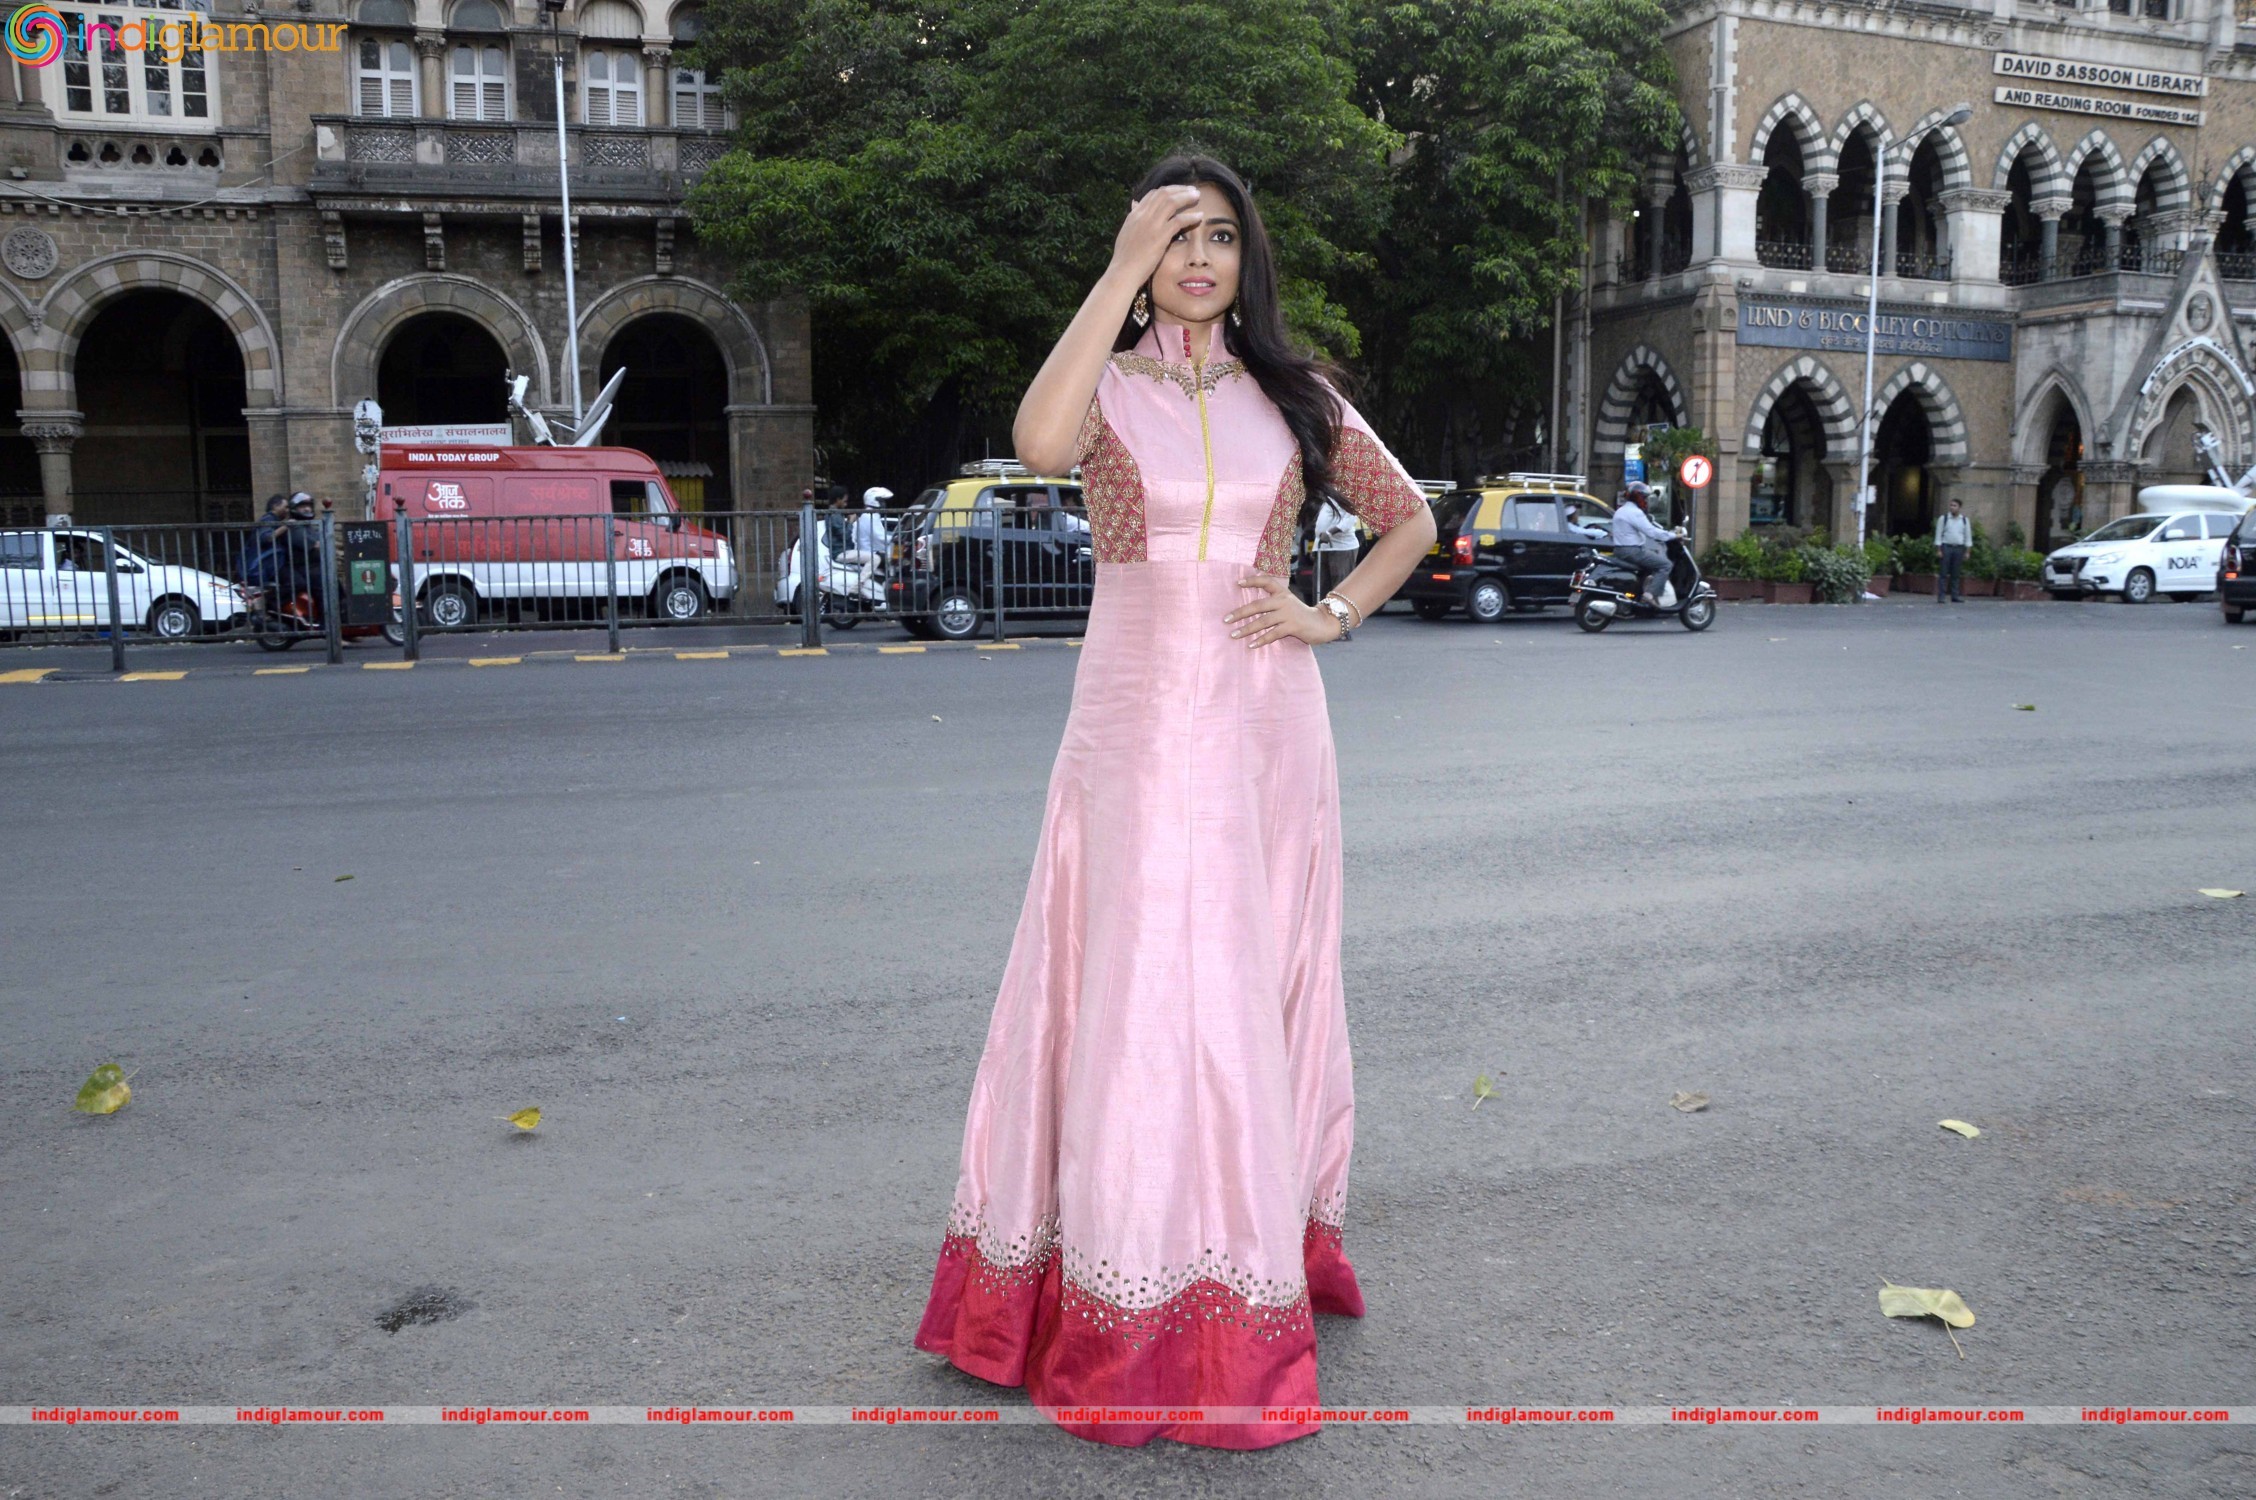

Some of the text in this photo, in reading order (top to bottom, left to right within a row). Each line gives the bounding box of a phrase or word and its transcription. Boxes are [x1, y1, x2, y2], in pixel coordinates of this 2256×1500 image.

[2002, 57, 2202, 92] DAVID SASSOON LIBRARY
[2004, 90, 2032, 104] AND
[2034, 93, 2091, 111] READING
[2094, 100, 2131, 115] ROOM
[2136, 107, 2179, 121] FOUNDED
[1746, 305, 1793, 328] LUND
[1798, 309, 1814, 329] &
[381, 426, 508, 441] पुराभिलेख संचालनालय
[408, 453, 500, 462] INDIA TODAY GROUP
[2168, 556, 2198, 570] INDIA
